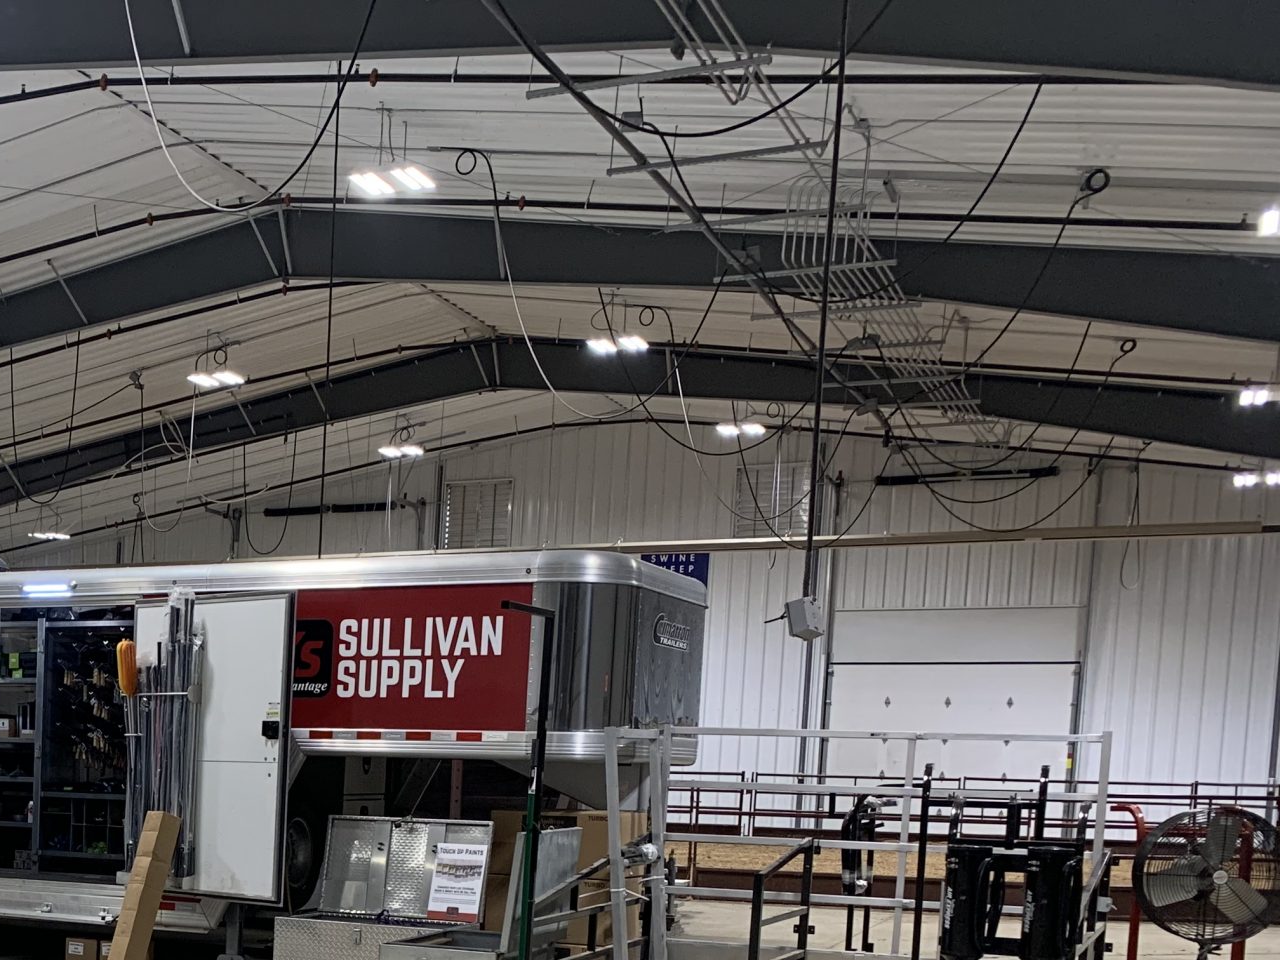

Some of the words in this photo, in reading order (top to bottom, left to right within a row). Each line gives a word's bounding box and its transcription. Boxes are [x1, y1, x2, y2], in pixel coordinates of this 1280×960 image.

[651, 554, 695, 562] SWINE
[338, 615, 504, 657] SULLIVAN
[660, 637, 687, 649] TRAILERS
[292, 681, 328, 695] antage
[336, 658, 465, 698] SUPPLY
[944, 898, 952, 929] EXPRESS
[1023, 902, 1032, 933] EXPRESS
